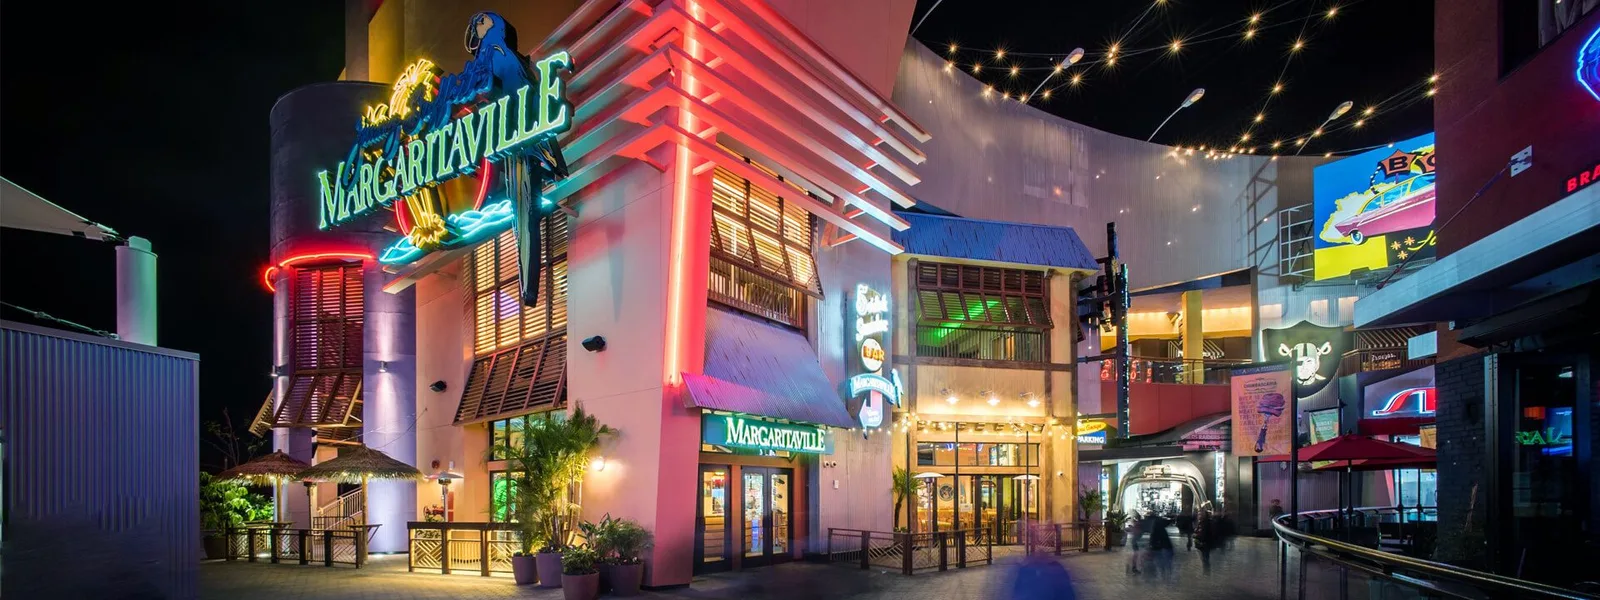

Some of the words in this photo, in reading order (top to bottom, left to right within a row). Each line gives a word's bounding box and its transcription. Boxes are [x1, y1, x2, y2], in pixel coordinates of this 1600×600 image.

[317, 51, 571, 230] MARGARITAVILLE
[863, 345, 885, 361] BAR
[726, 416, 826, 451] MARGARITAVILLE
[1077, 435, 1105, 444] PARKING
